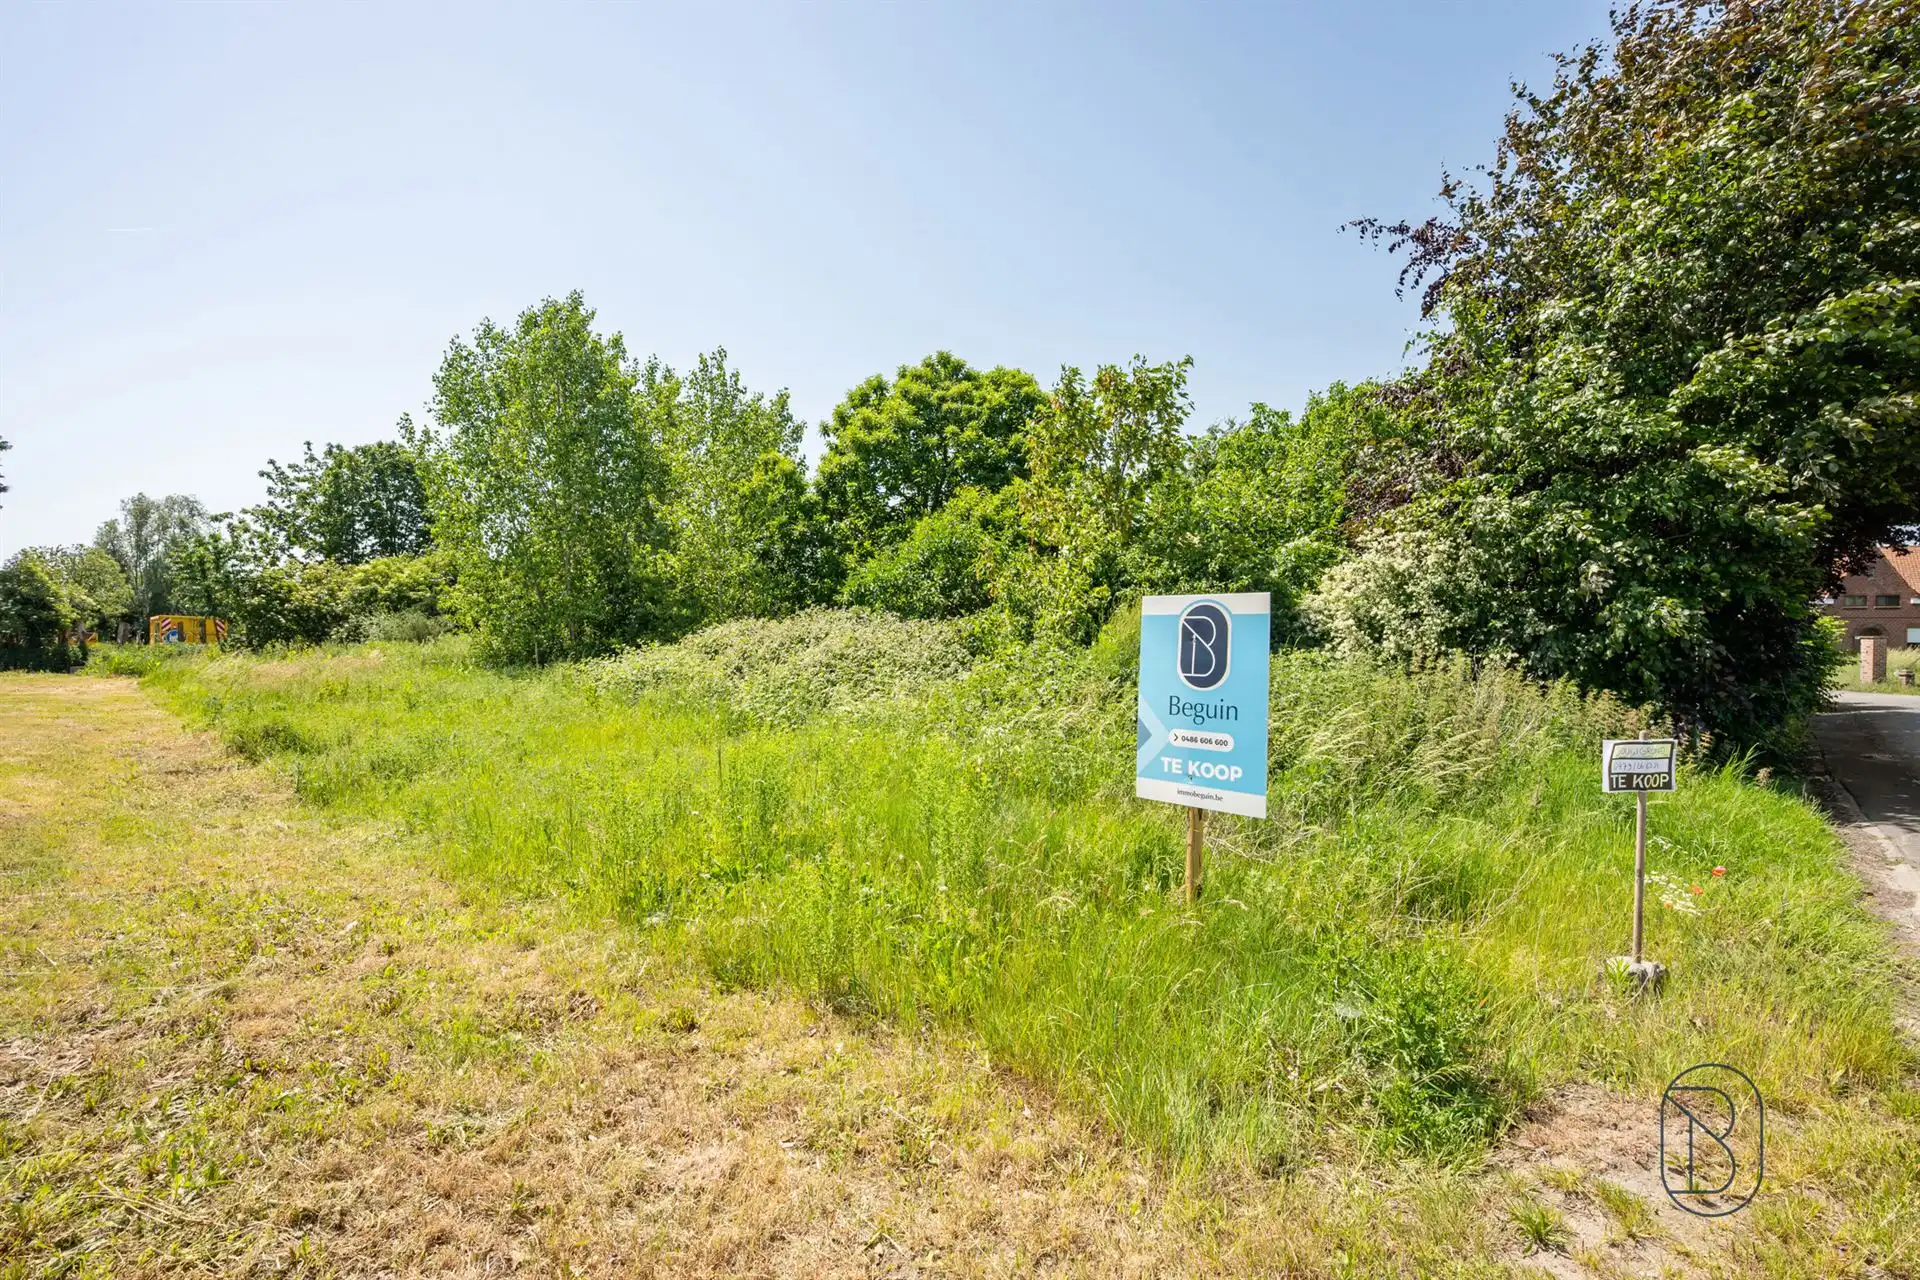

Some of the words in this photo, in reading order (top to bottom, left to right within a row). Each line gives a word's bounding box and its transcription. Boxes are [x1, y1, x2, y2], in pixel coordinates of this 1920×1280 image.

[1169, 695, 1238, 725] Beguin
[1181, 735, 1198, 744] 0486
[1200, 737, 1213, 746] 606
[1215, 738, 1228, 747] 600
[1161, 757, 1182, 774] TE
[1188, 761, 1242, 782] KOOP
[1611, 774, 1627, 788] TE
[1632, 774, 1669, 788] KOOP
[1177, 788, 1223, 802] immobeguin.be
